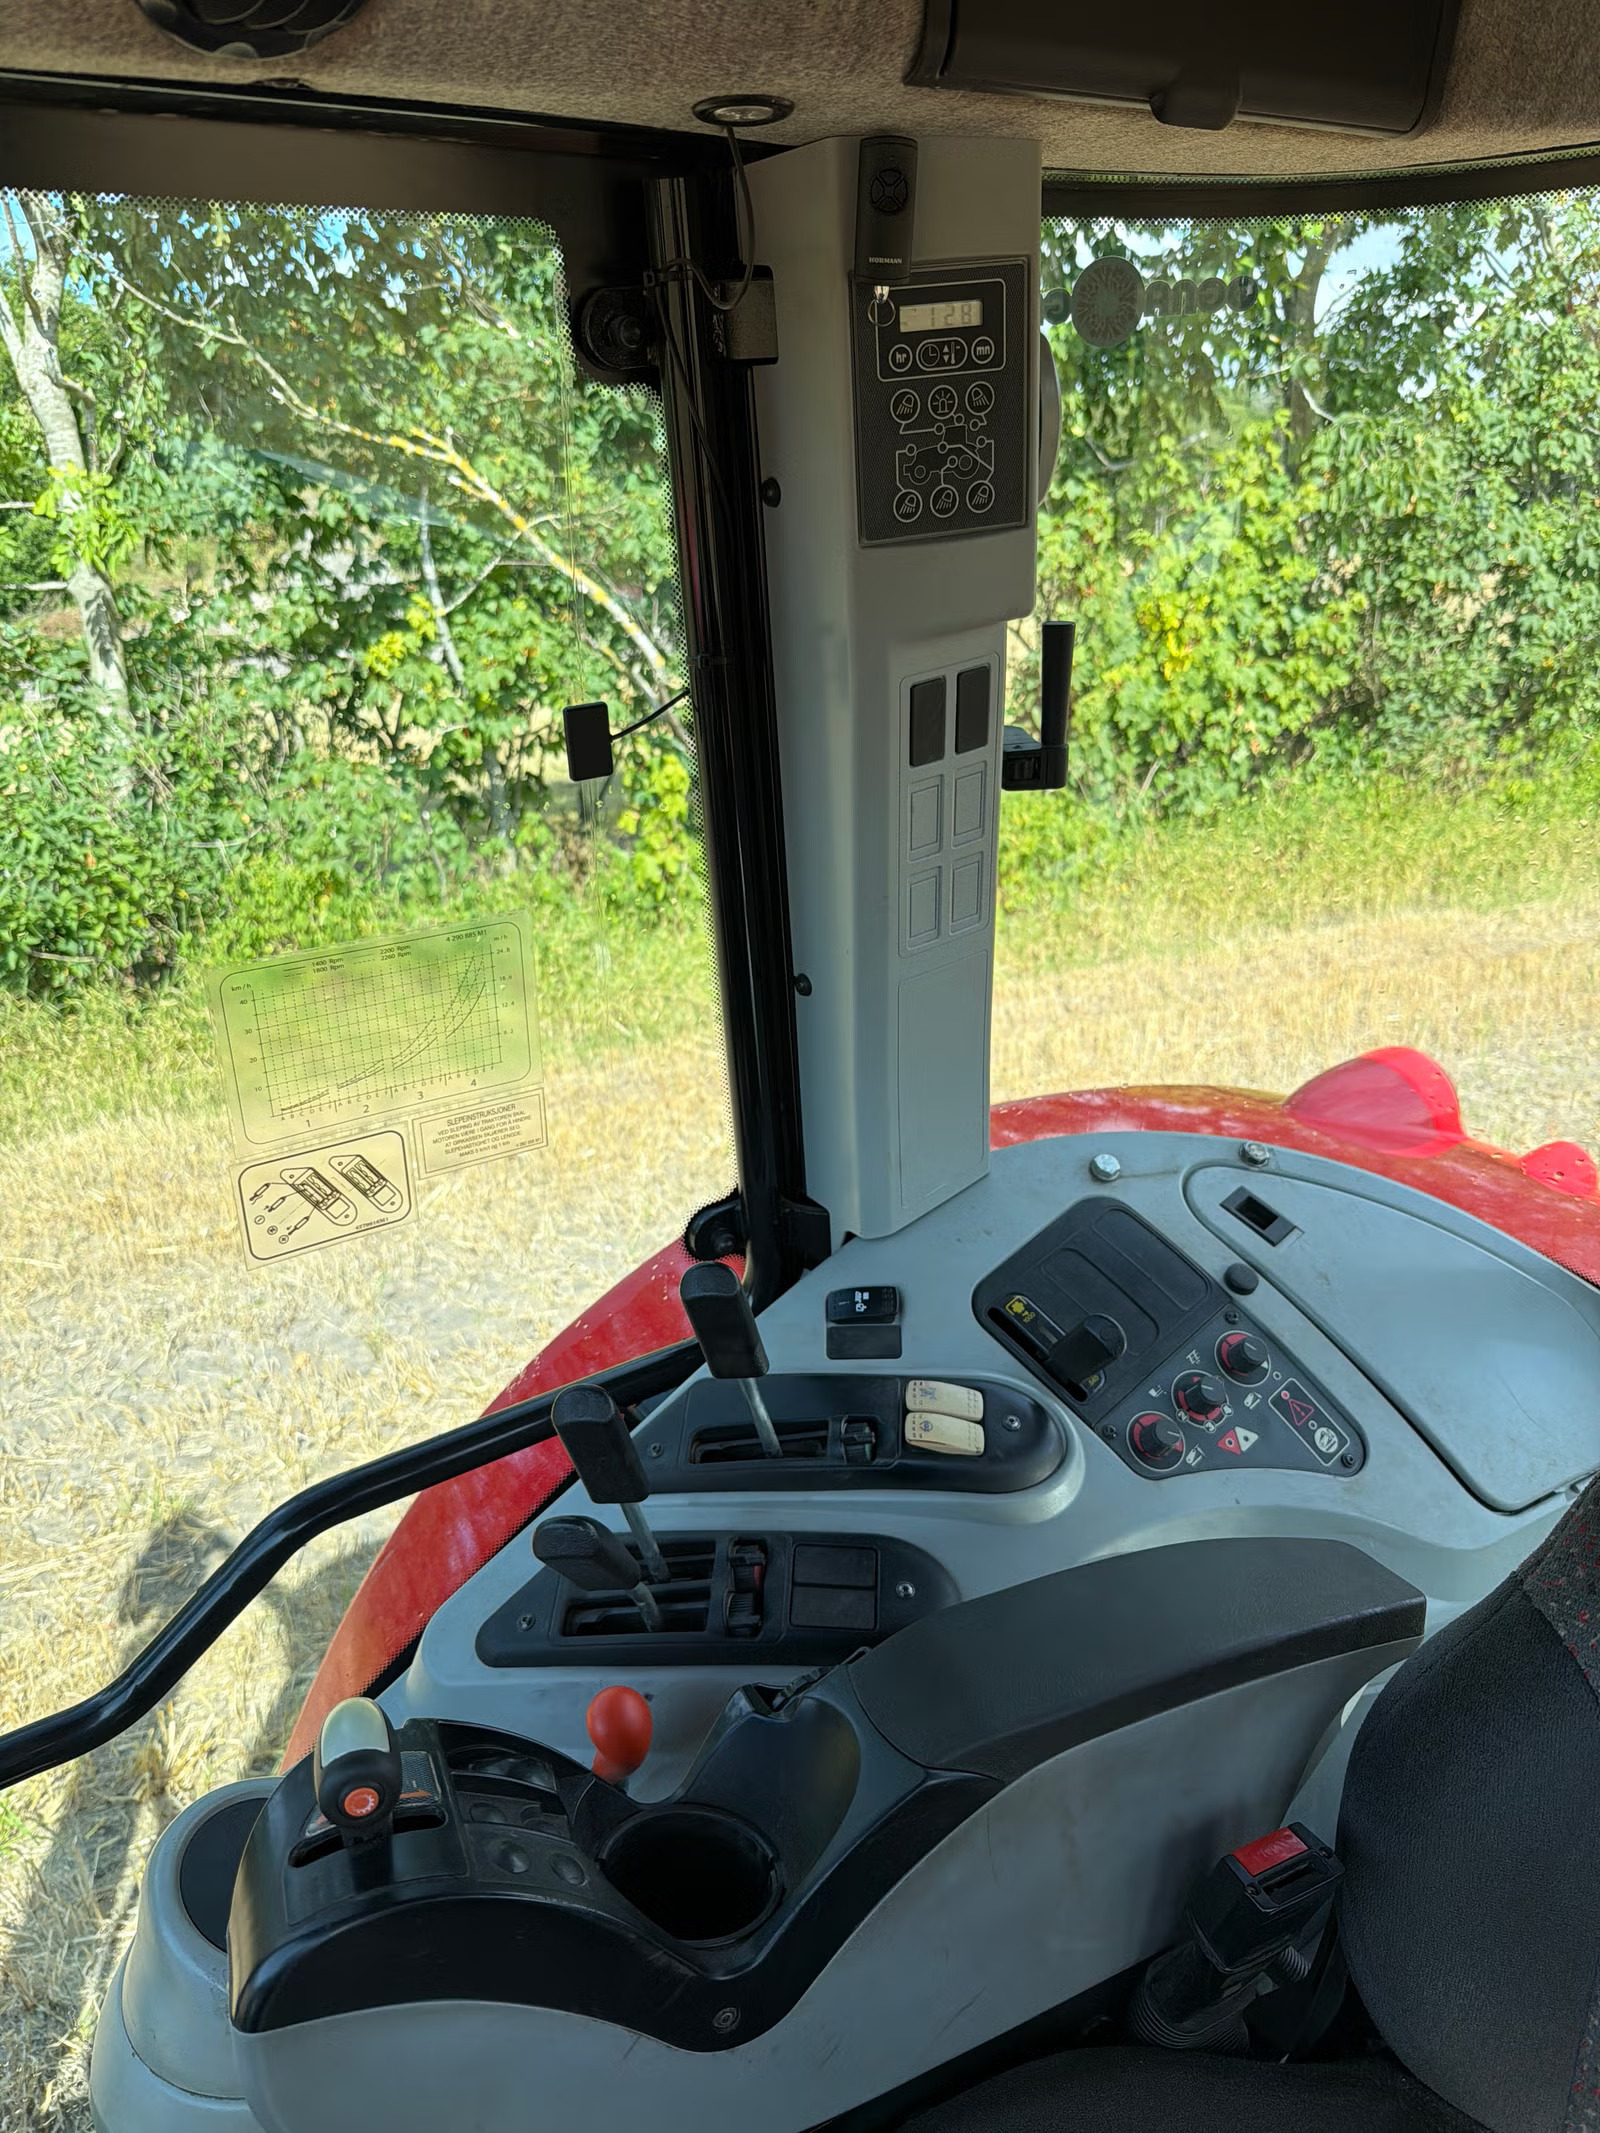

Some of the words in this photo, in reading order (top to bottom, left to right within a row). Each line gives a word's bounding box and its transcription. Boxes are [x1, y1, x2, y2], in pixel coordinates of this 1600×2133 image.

[977, 345, 990, 356] mn
[896, 352, 906, 364] hr
[330, 958, 343, 966] Rpm
[330, 964, 344, 972] Rpm
[418, 1092, 424, 1100] 3
[363, 1105, 369, 1113] 2
[447, 1103, 516, 1127] SLEPEINSTRUKSJONER
[450, 1123, 472, 1133] SLEPING
[481, 1113, 512, 1125] TRAKTOREN
[433, 1133, 460, 1144] MOTOREN
[480, 1124, 495, 1132] GANG
